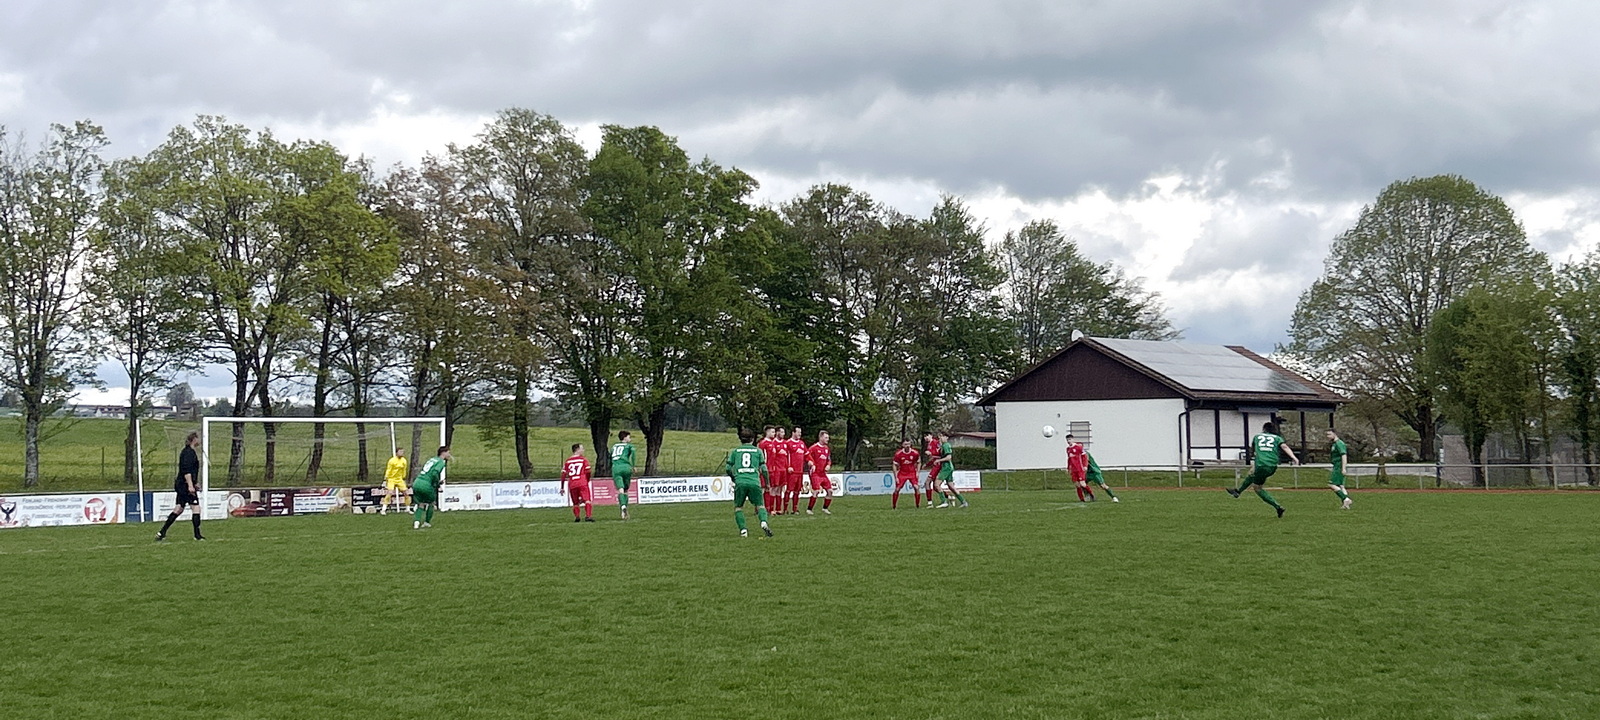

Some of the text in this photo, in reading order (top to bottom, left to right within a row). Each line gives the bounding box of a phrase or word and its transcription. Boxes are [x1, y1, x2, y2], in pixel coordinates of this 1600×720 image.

[1257, 435, 1275, 448] 22
[742, 452, 751, 468] 8
[568, 463, 583, 476] 37
[495, 484, 564, 498] Limes-Apothek
[640, 486, 656, 495] TBG
